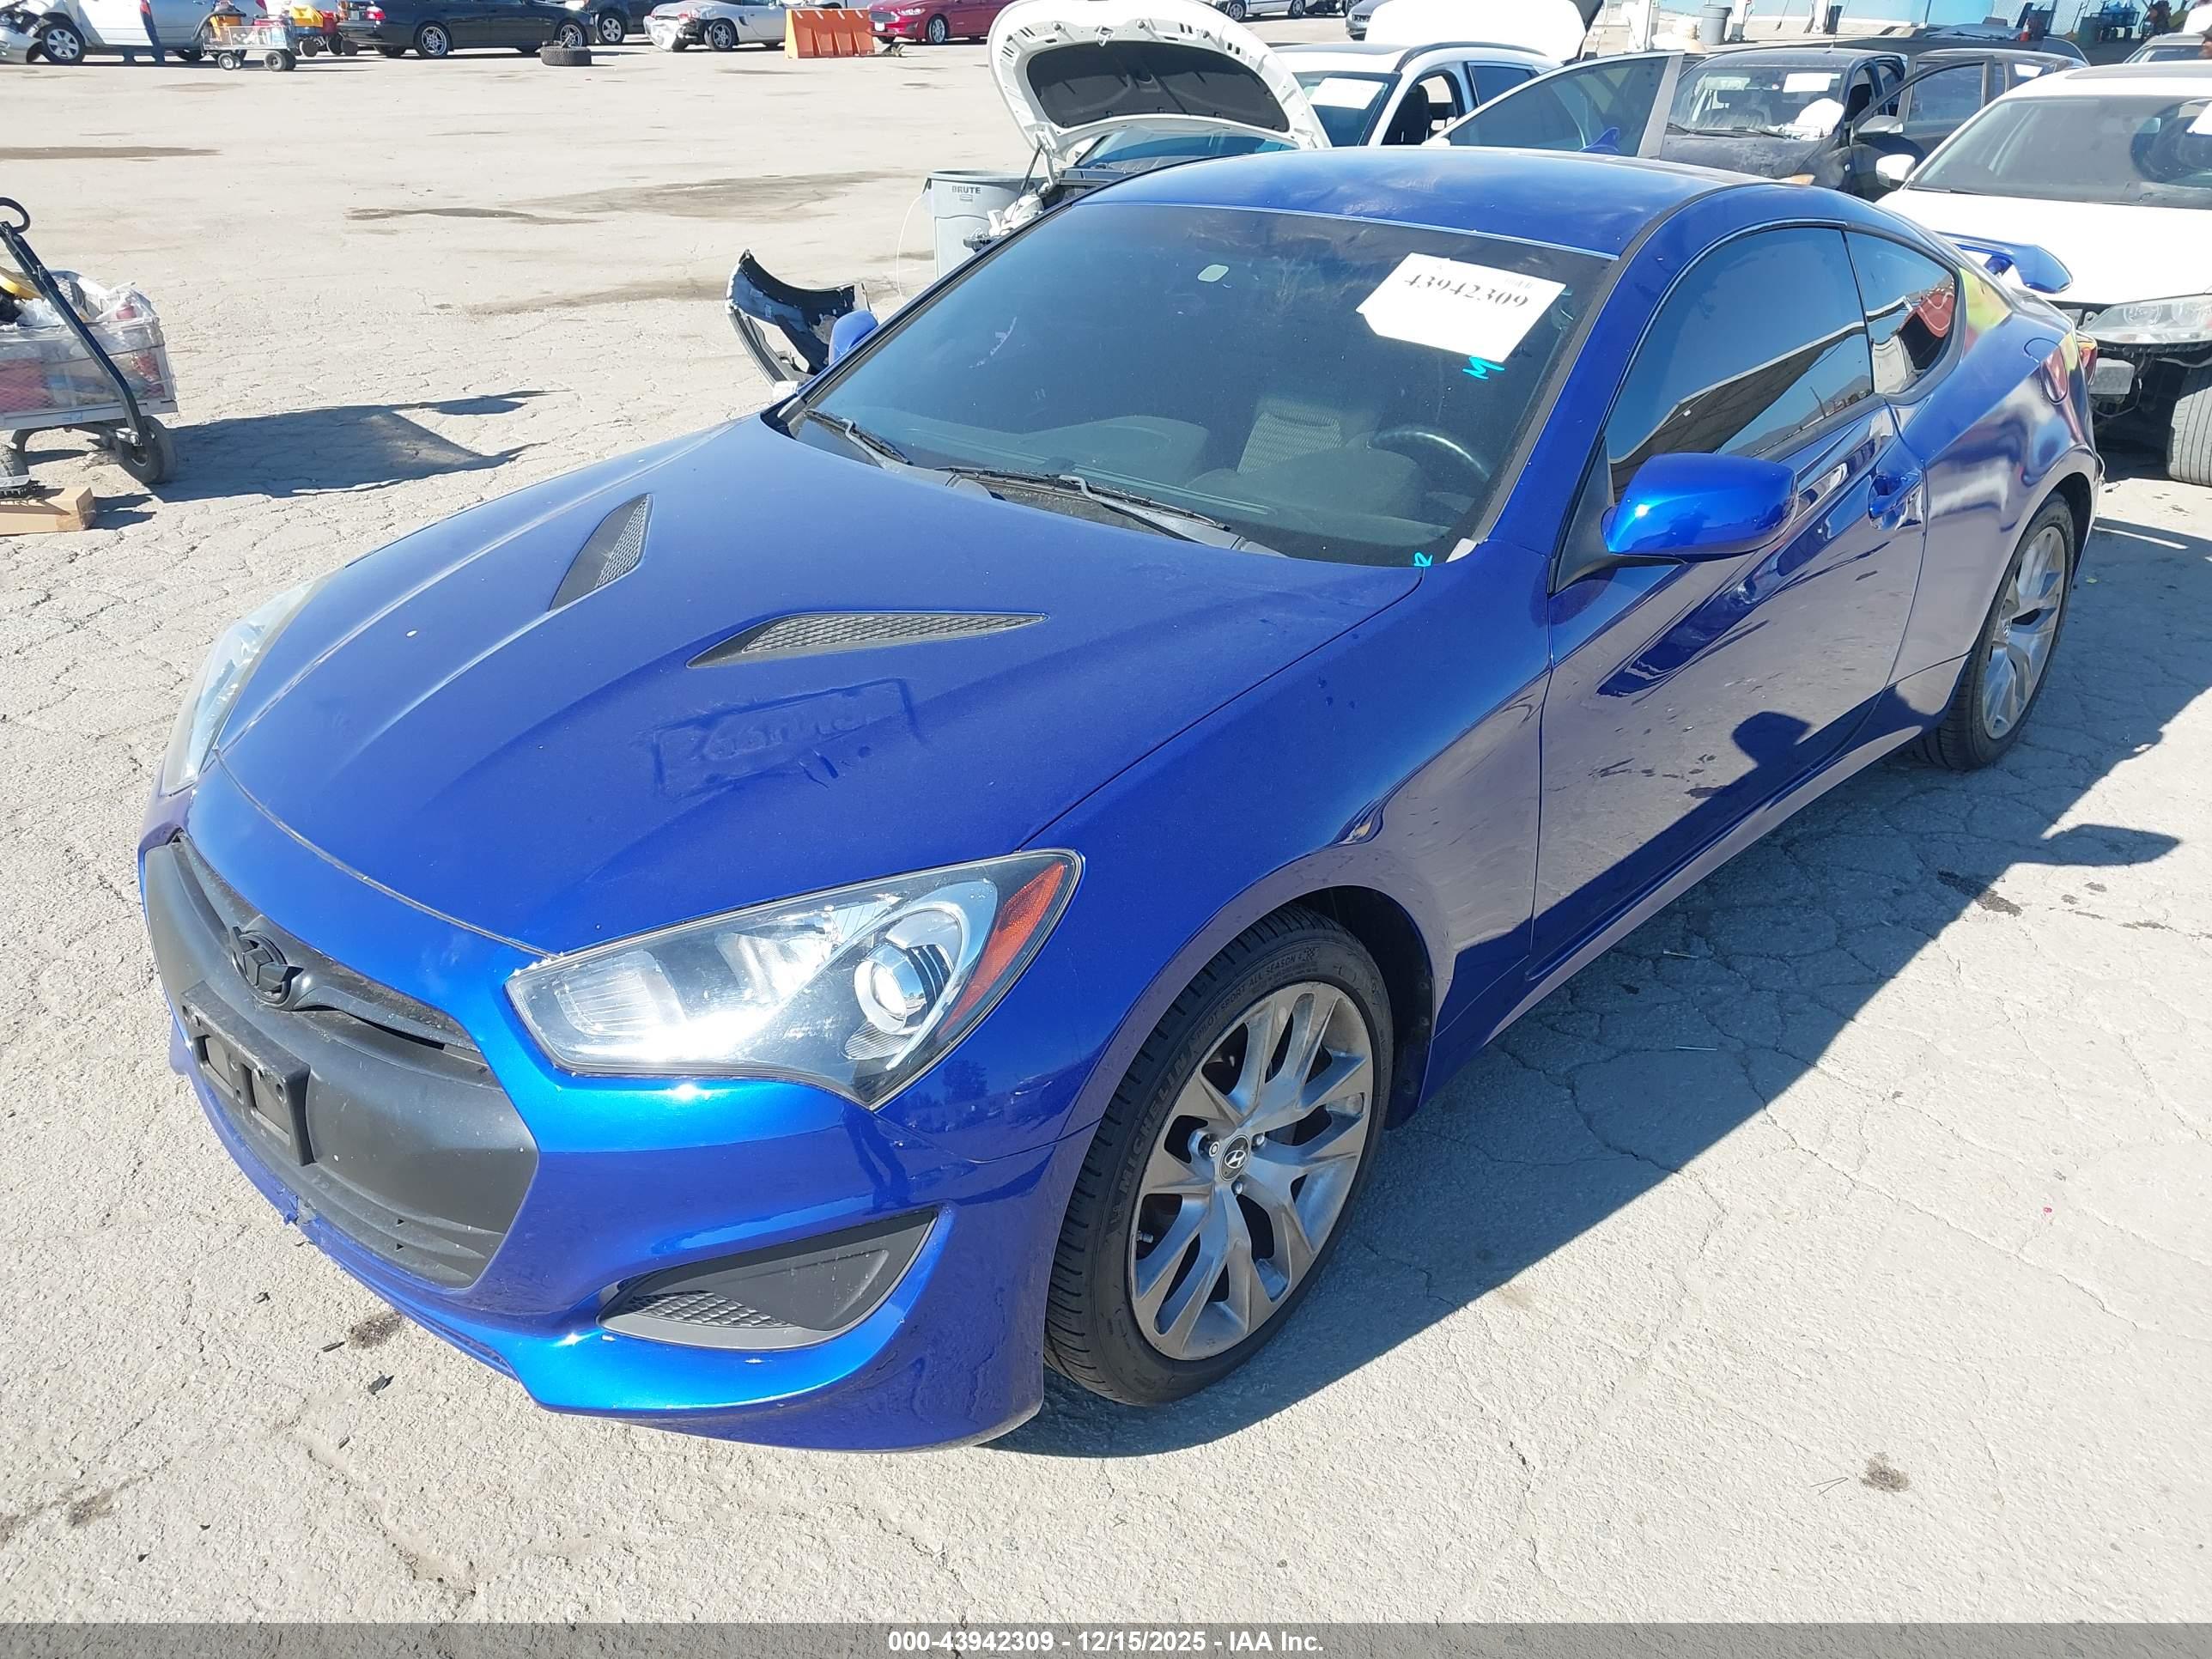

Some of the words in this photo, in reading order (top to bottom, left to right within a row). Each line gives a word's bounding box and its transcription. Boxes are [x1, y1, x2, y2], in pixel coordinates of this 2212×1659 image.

[951, 185, 981, 194] BRUTE
[1404, 273, 1529, 307] 43942309
[1195, 1013, 1219, 1037] PILOT
[1220, 984, 1247, 1010] SPORT
[1249, 973, 1265, 988] ALL
[1265, 954, 1296, 977] SEASON
[1119, 1053, 1188, 1194] MICHELIN
